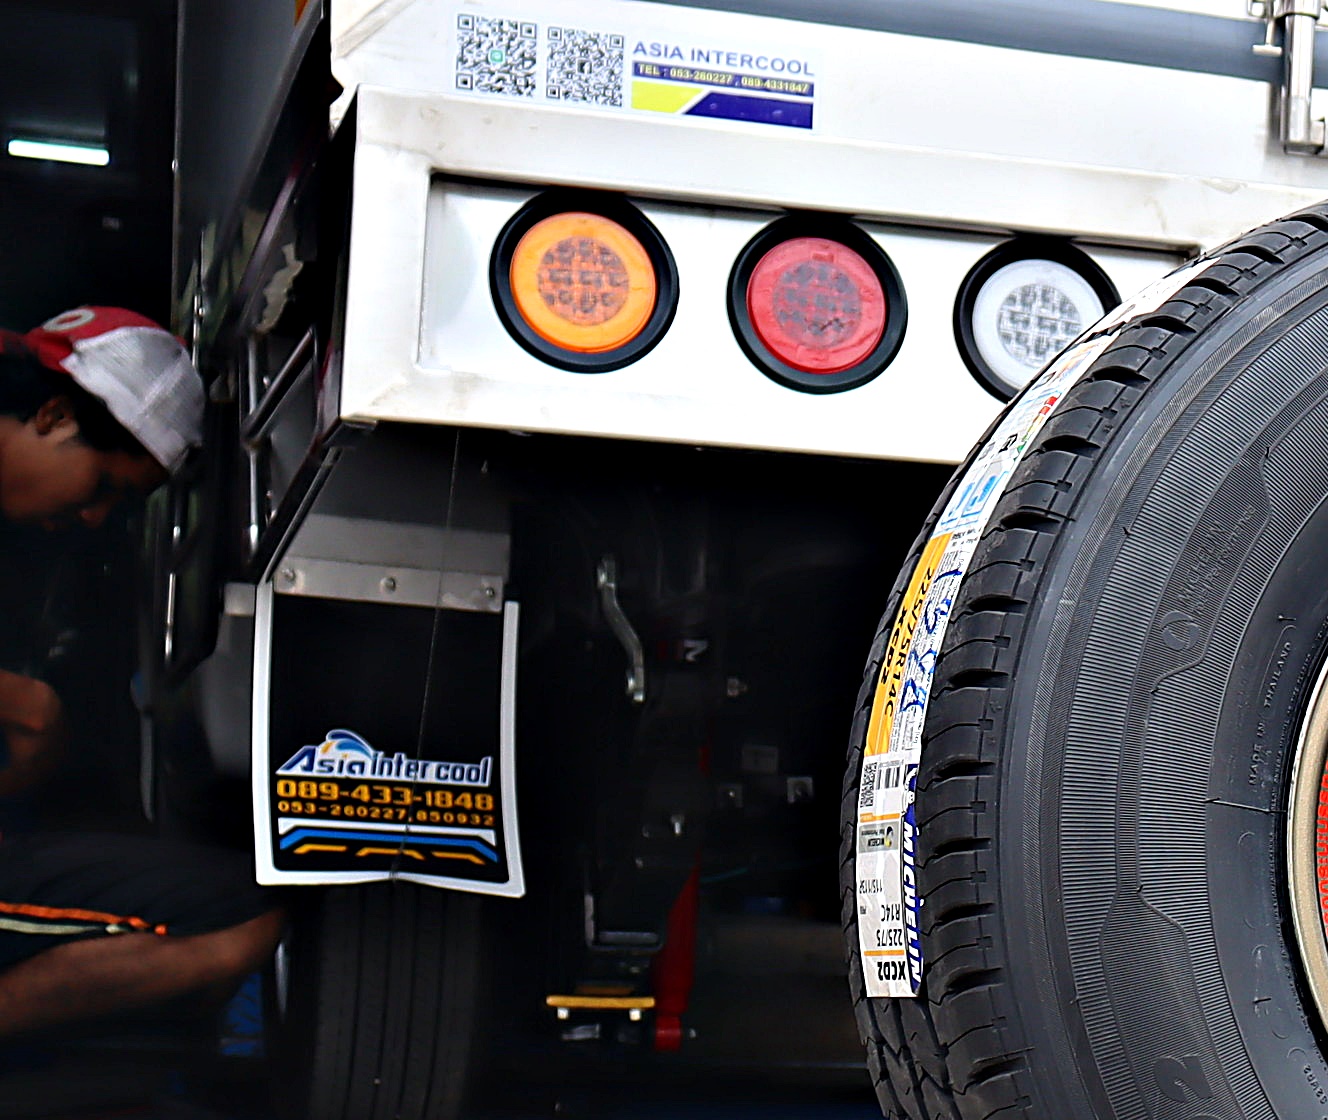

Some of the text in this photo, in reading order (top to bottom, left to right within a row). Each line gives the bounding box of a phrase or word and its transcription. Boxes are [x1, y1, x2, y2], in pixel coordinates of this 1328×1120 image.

[633, 41, 815, 76] ASIA INTERCOOL
[639, 64, 660, 76] TEL
[276, 745, 366, 778] Asia
[277, 780, 495, 811] 089-433-1848
[880, 904, 901, 922] R14C
[901, 822, 924, 982] MICHELIN
[876, 928, 903, 948] 225/75
[877, 961, 906, 982] XCD2
